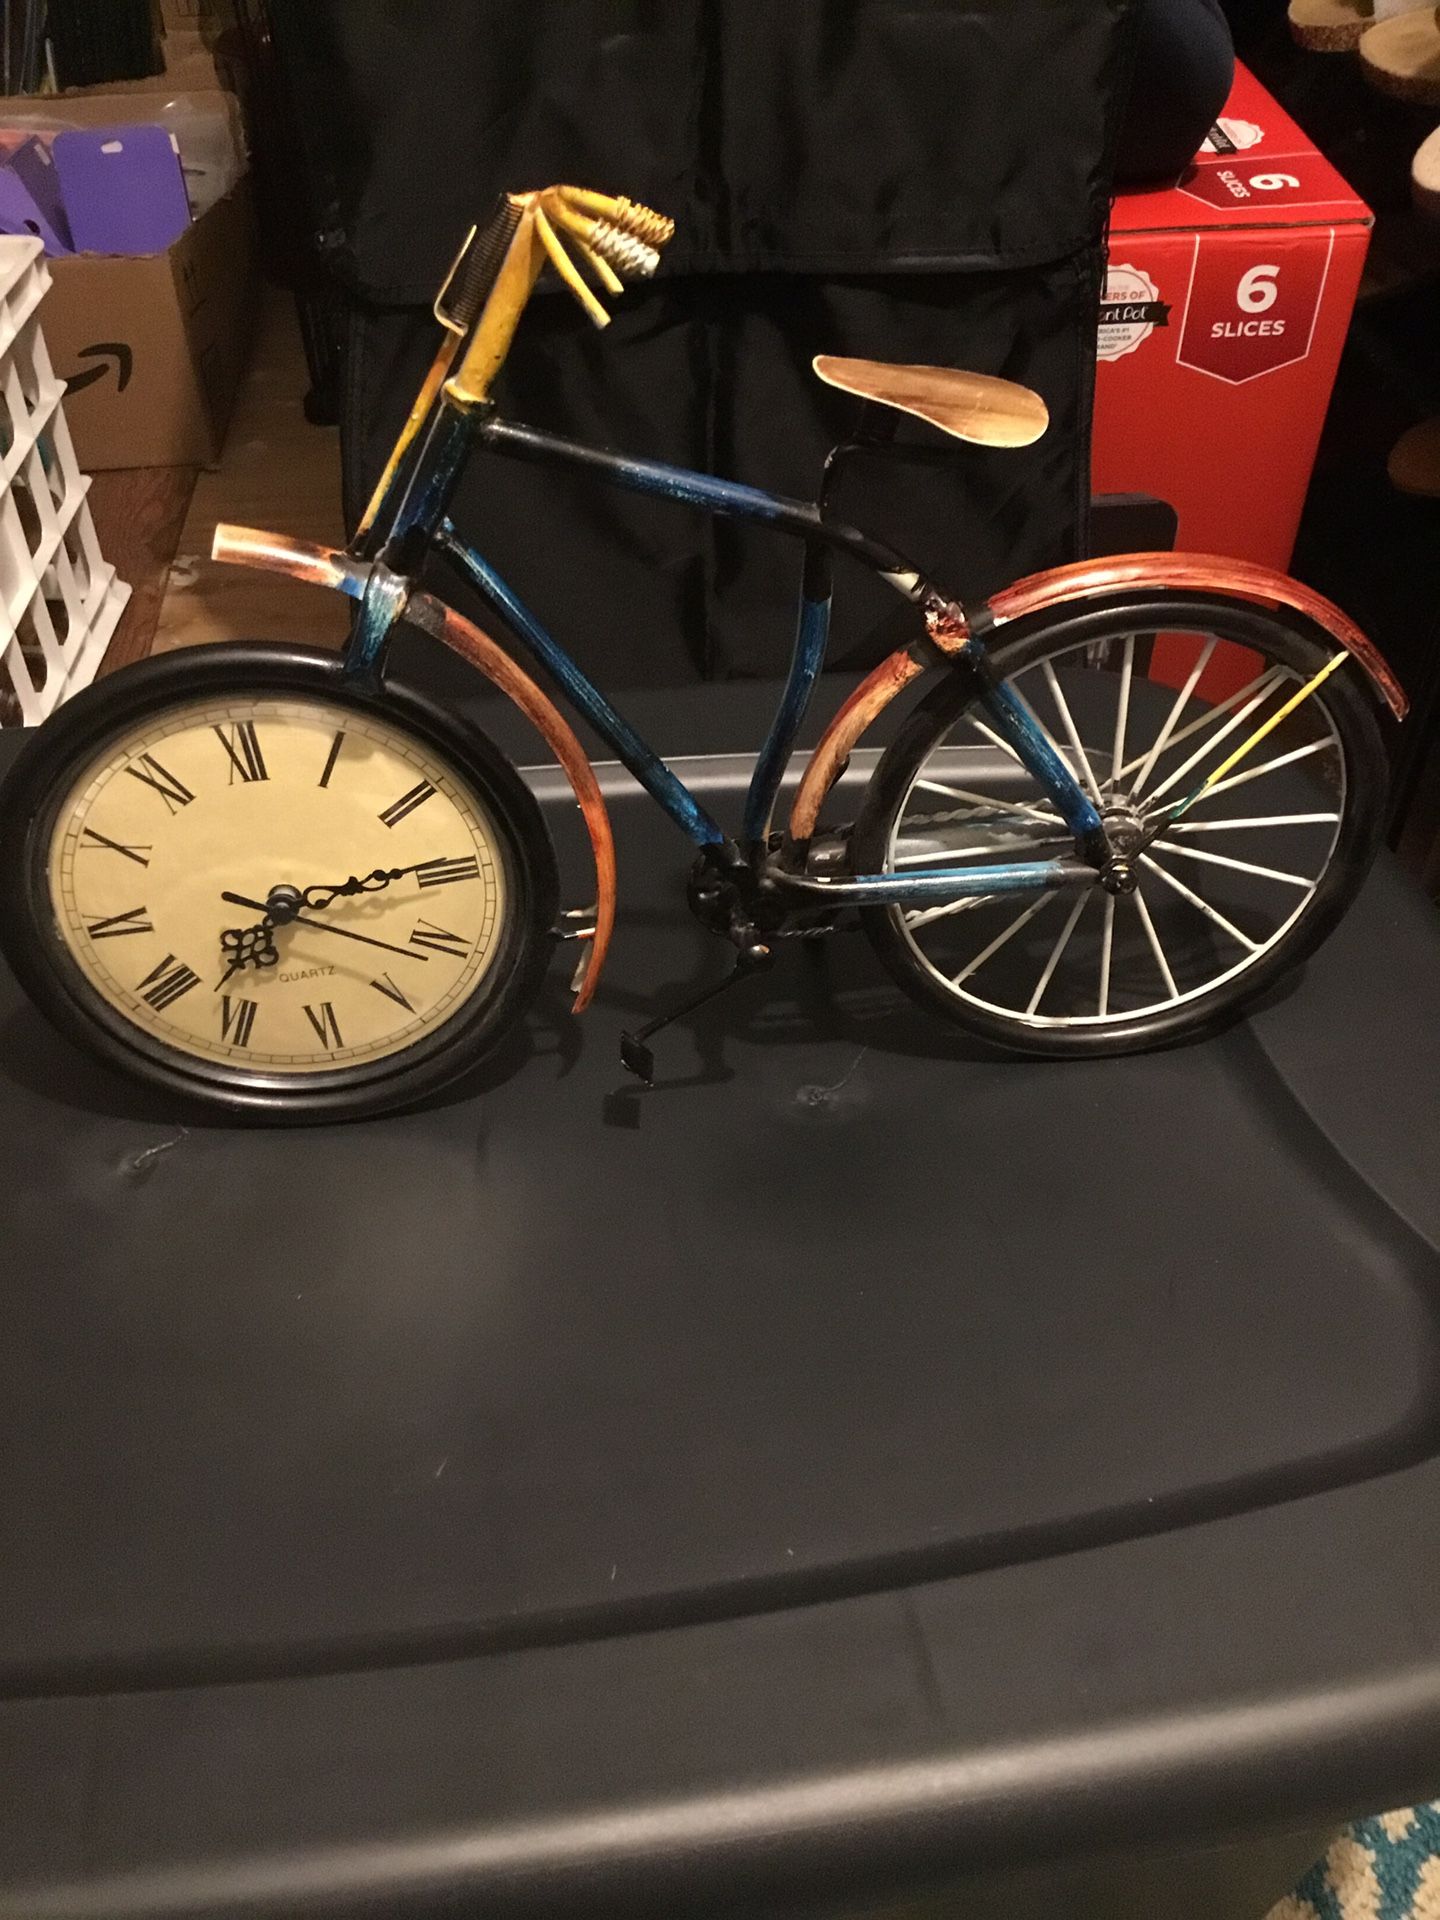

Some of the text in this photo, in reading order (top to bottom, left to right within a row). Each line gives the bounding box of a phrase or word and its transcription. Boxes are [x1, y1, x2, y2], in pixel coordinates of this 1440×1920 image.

[1216, 170, 1251, 198] SLICES
[1249, 173, 1300, 190] 6
[1129, 290, 1146, 300] OF
[1236, 264, 1281, 314] 6
[1122, 305, 1146, 321] Pot
[1211, 320, 1286, 338] SLICES
[212, 719, 271, 785] XII
[124, 752, 197, 816] XI
[79, 827, 153, 868] X
[279, 964, 336, 983] QUARTZ
[221, 994, 259, 1048] VII
[302, 1001, 345, 1050] VI
